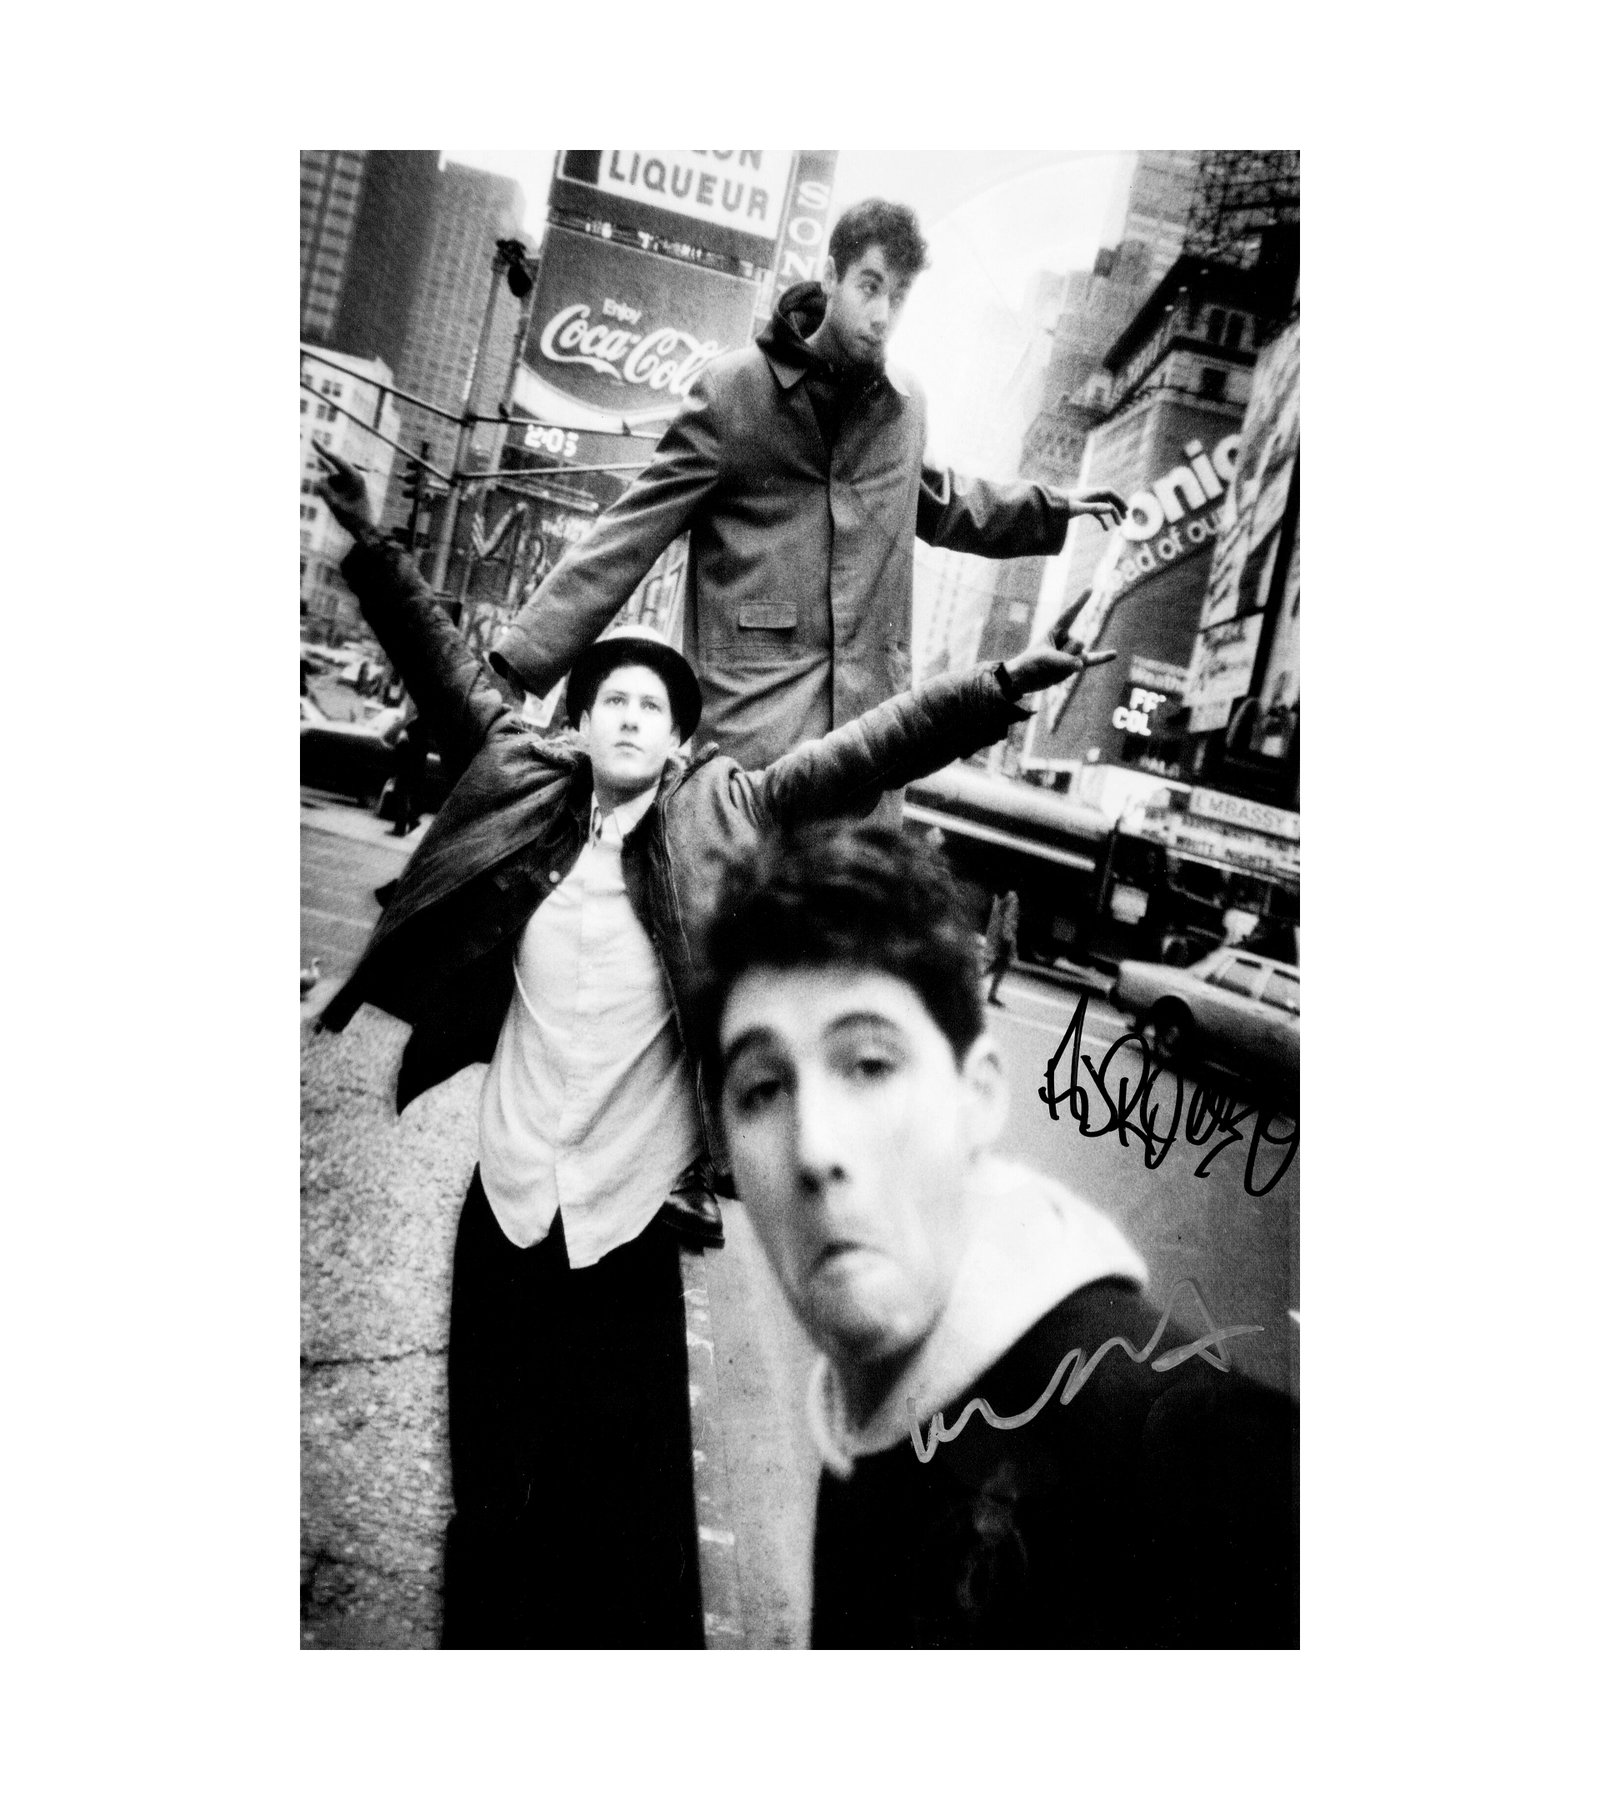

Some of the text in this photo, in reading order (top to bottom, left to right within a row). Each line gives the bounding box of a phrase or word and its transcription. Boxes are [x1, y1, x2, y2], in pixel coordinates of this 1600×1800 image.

[608, 150, 770, 221] LIQUEUR
[602, 297, 642, 325] Enjoy
[1158, 525, 1184, 560] of
